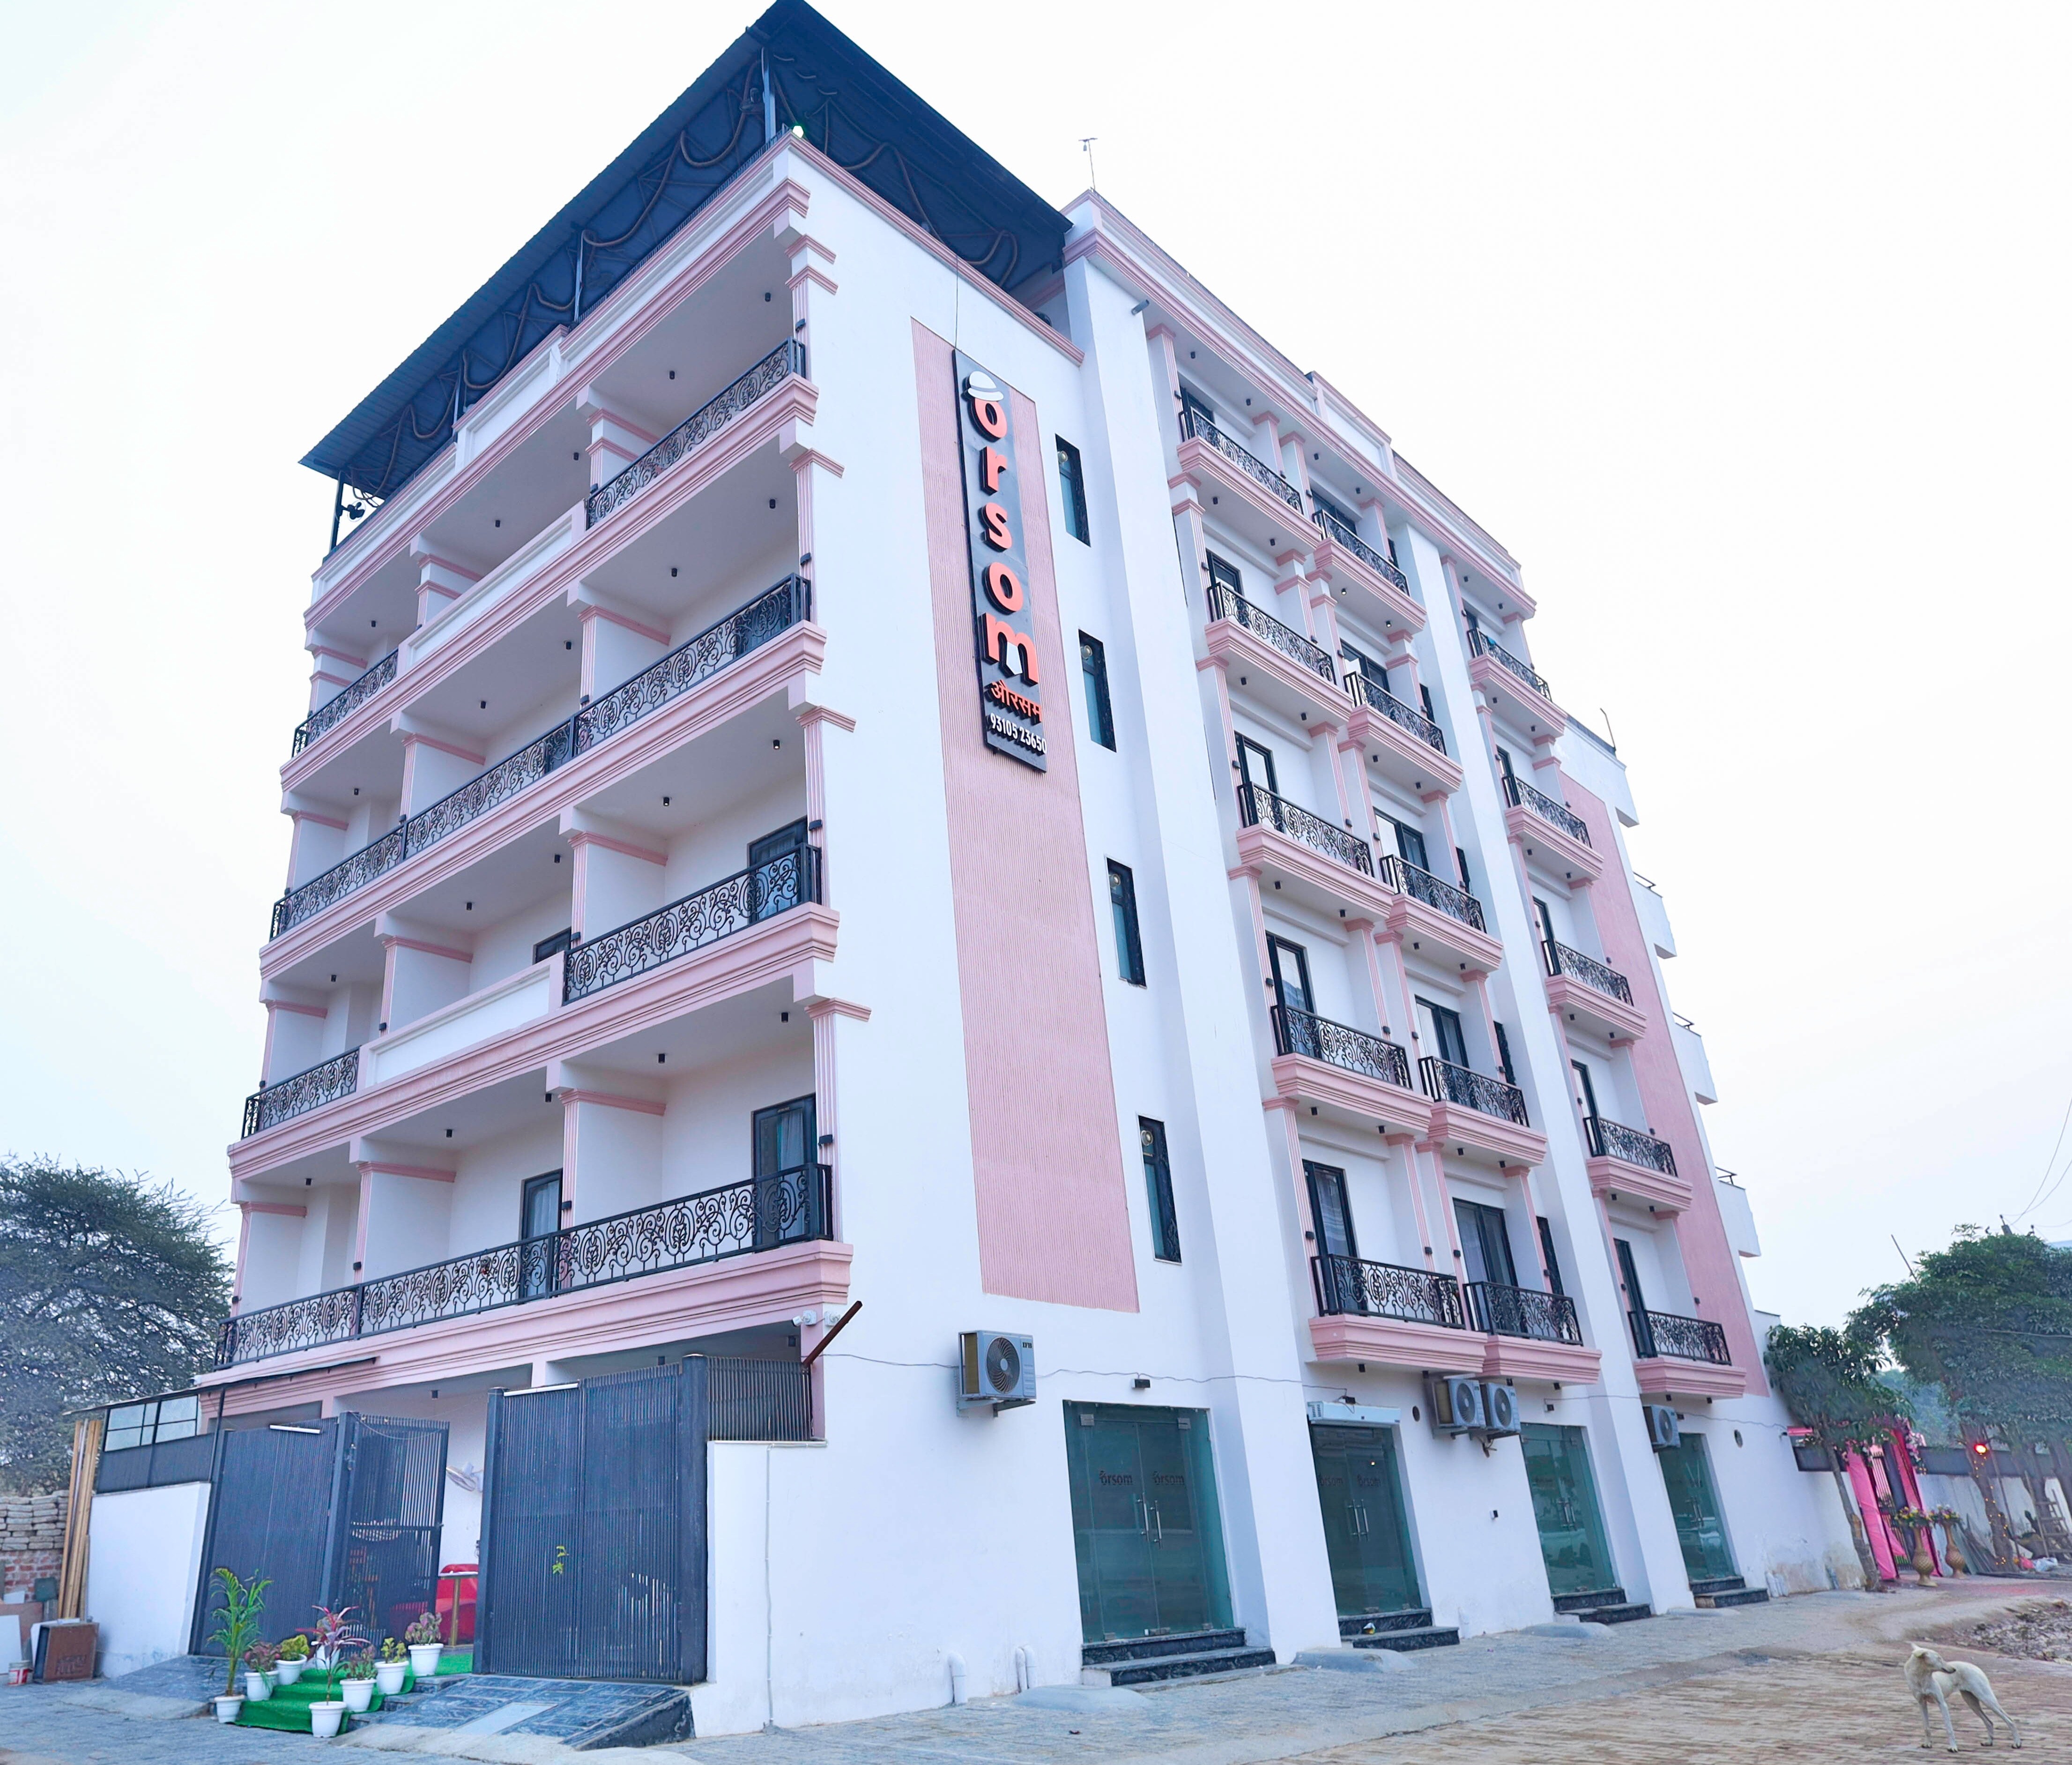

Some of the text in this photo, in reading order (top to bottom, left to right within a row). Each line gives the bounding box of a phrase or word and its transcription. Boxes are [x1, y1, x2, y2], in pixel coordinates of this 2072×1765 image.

[973, 397, 1038, 684] orsom
[991, 679, 1042, 722] औरसम
[990, 712, 1047, 754] 93105 23650
[1099, 1474, 1133, 1486] orsom
